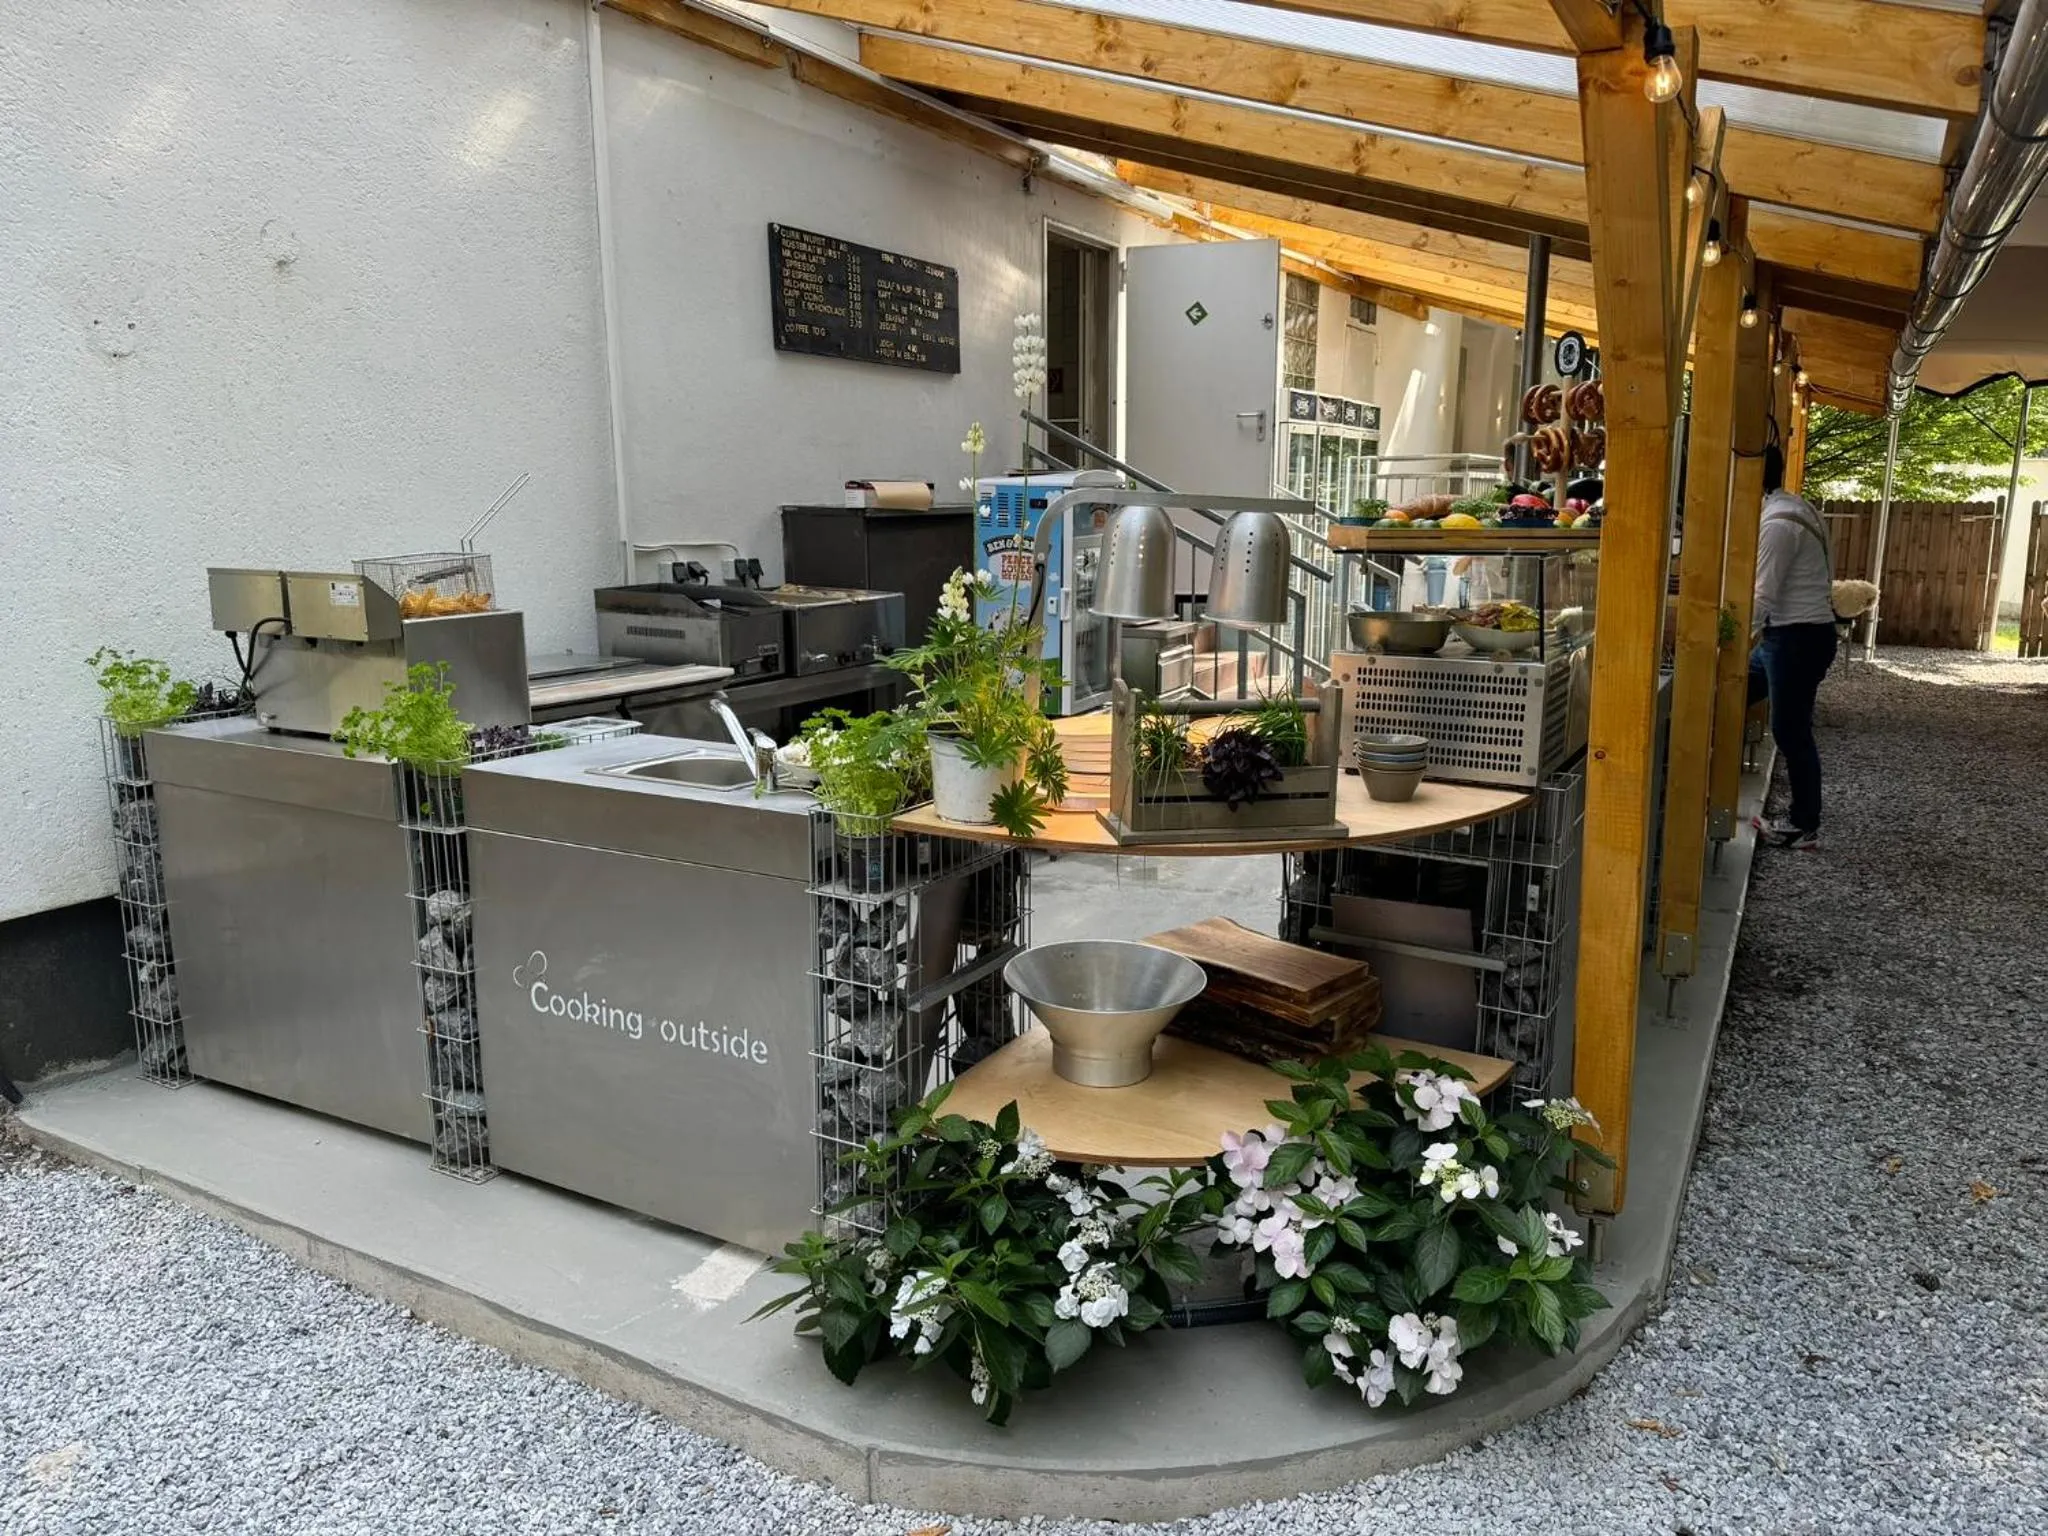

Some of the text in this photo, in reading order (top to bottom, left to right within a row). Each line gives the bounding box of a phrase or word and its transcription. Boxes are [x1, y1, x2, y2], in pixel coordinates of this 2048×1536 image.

[986, 539, 1006, 553] BEN
[530, 981, 769, 1064] Cooking outside
